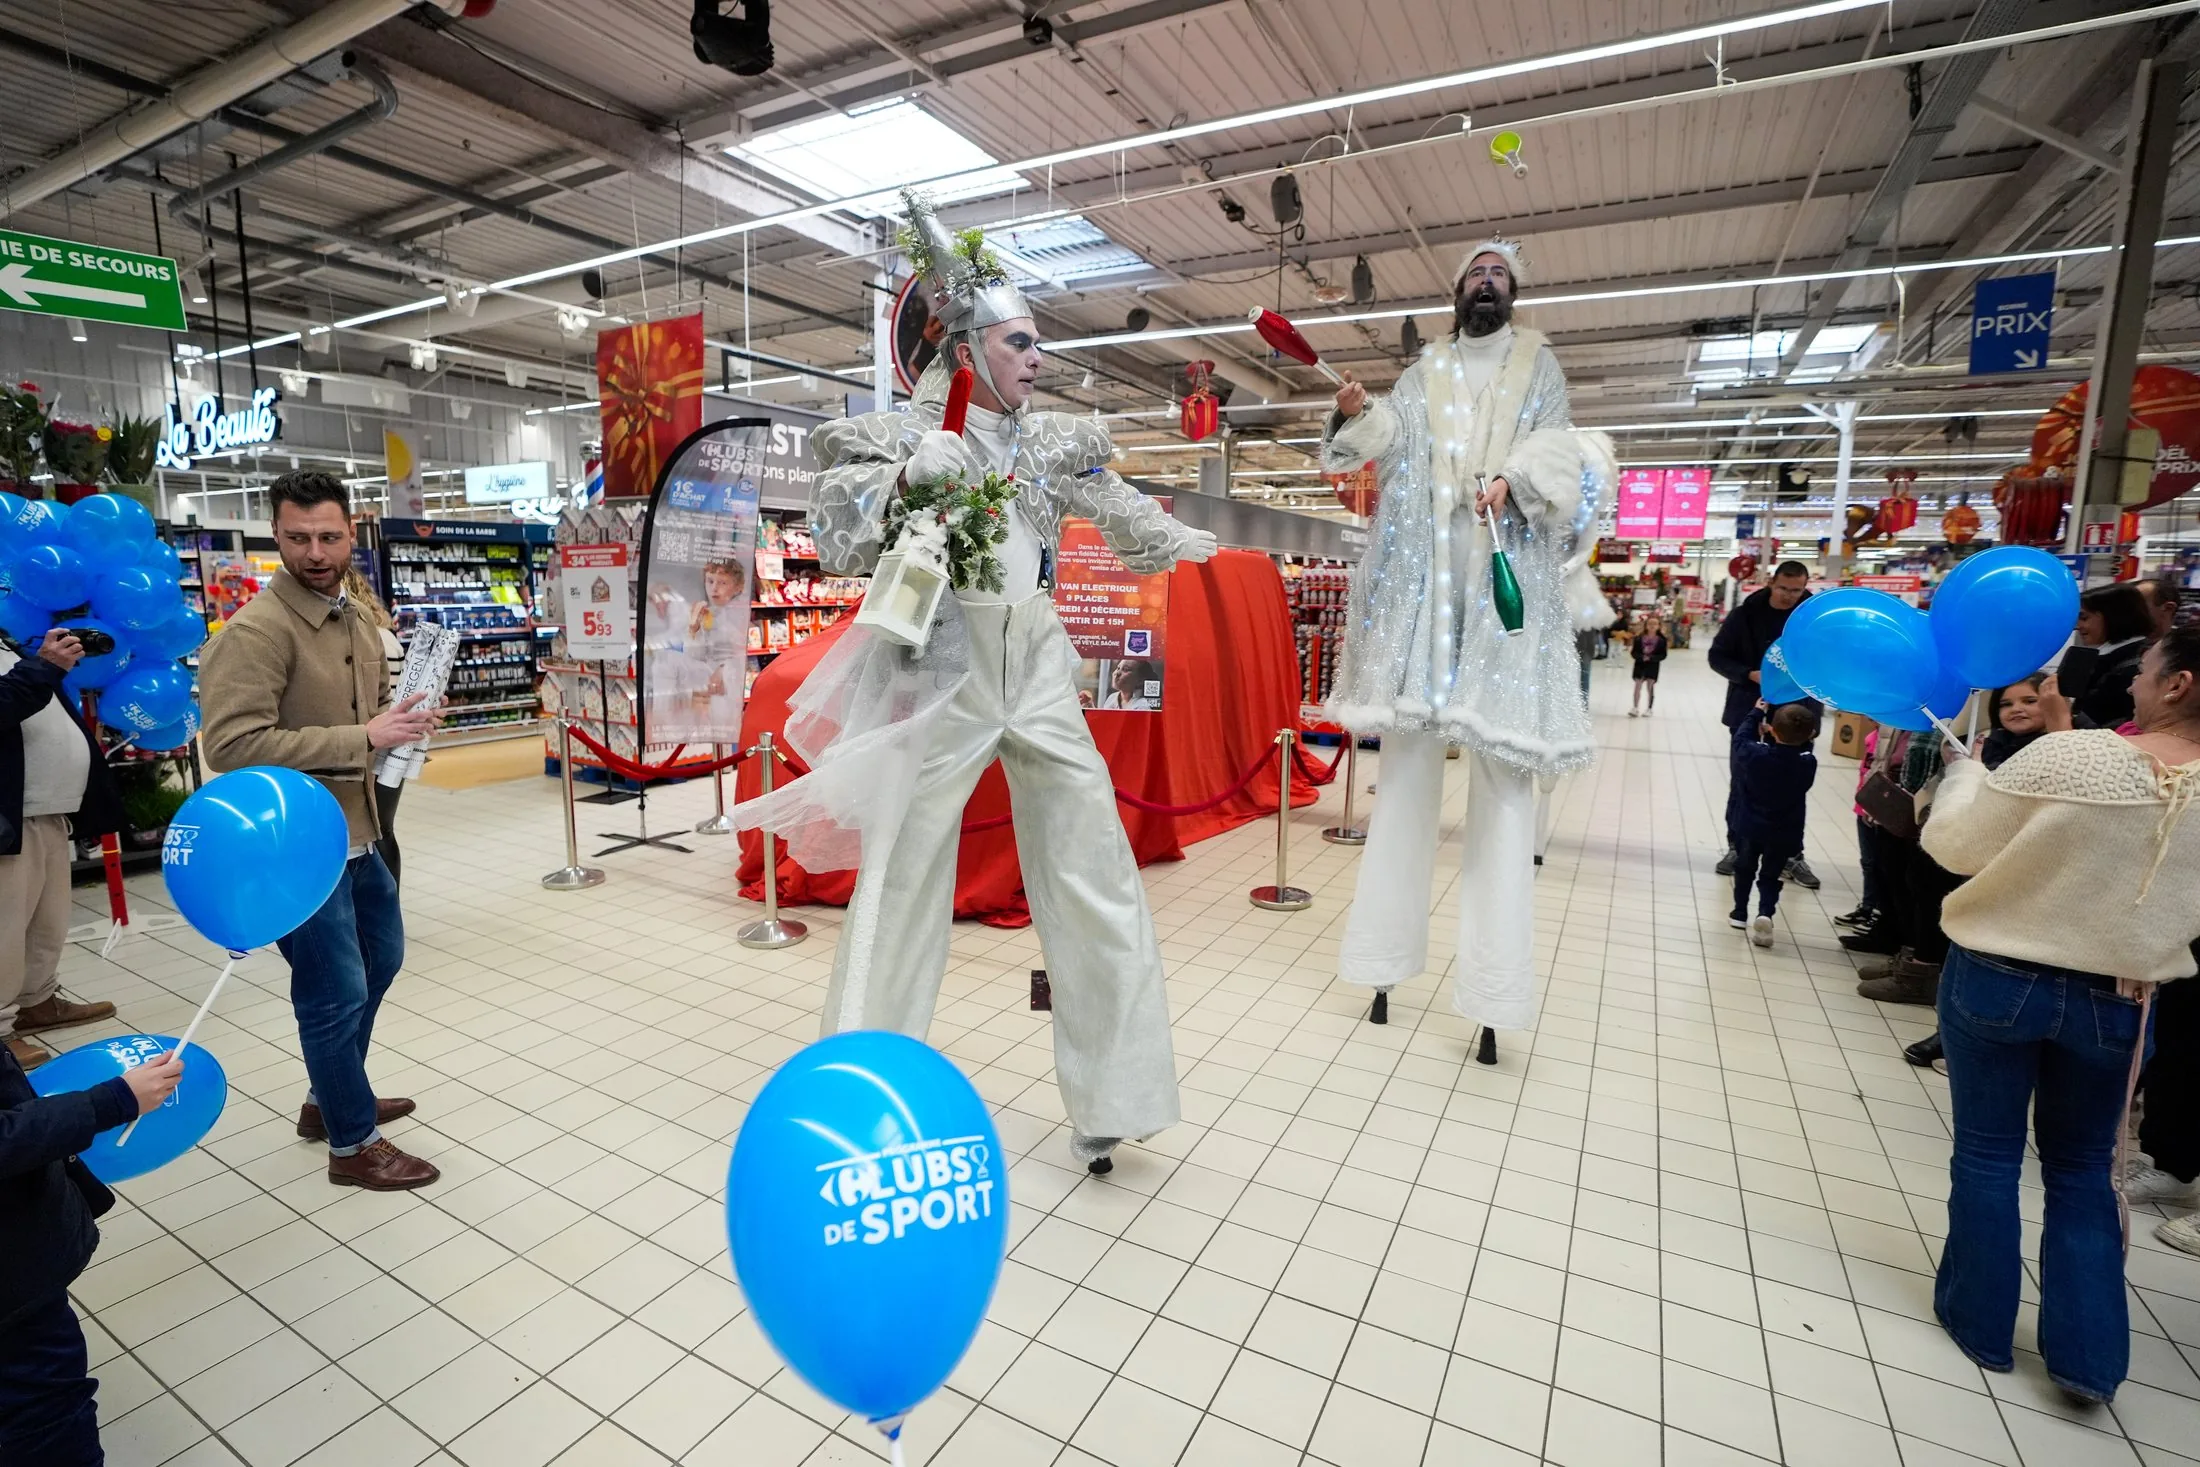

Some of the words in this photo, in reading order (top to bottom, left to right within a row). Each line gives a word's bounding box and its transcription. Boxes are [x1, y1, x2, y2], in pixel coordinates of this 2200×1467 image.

[0, 239, 25, 258] IE
[30, 244, 64, 264] DE
[68, 252, 171, 281] SECOURS
[1975, 310, 2049, 338] PRIX
[155, 402, 191, 470] La
[193, 387, 276, 456] Beauté
[767, 423, 807, 457] ST
[711, 459, 764, 477] SPORT
[476, 528, 497, 536] BARBE
[1082, 584, 1138, 593] ELECTRIQUE
[1074, 595, 1109, 603] PLACES
[1054, 605, 1080, 613] CREDI
[1091, 605, 1141, 615] DÉCEMBRE
[1093, 617, 1105, 625] DE
[1107, 618, 1125, 626] 15H
[161, 846, 194, 866] ORT
[823, 1219, 857, 1247] DE
[861, 1180, 994, 1245] SPORT
